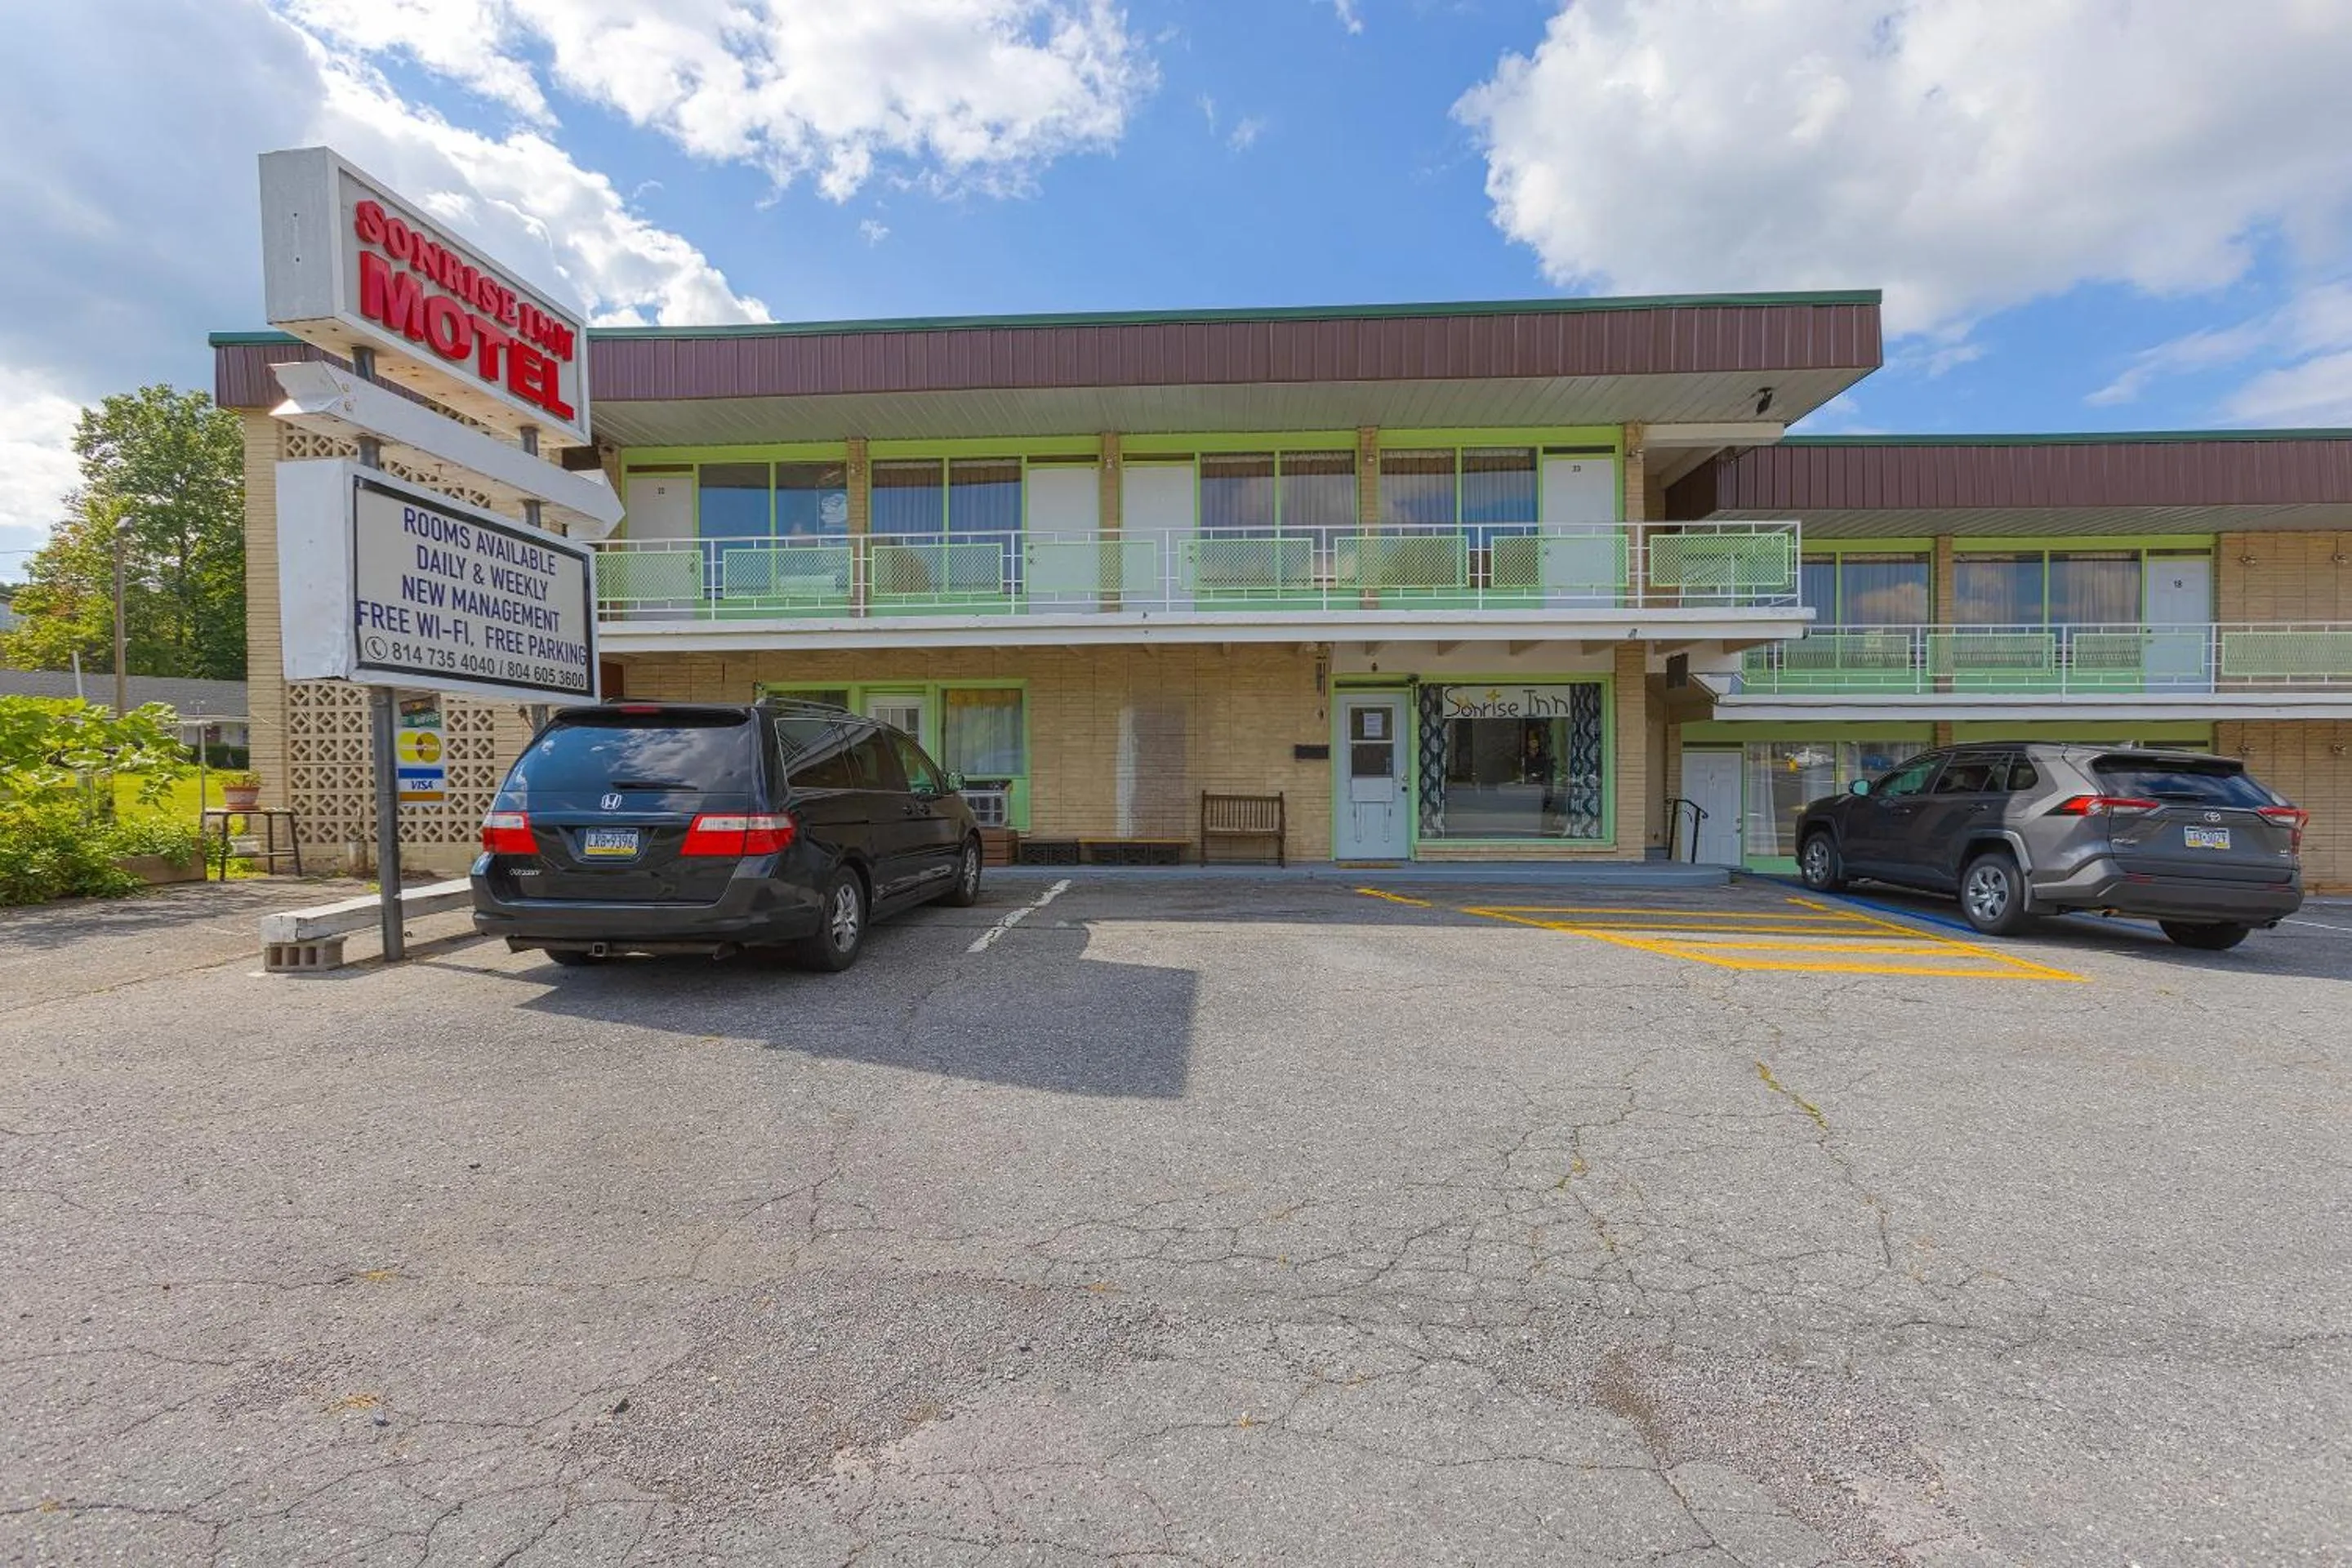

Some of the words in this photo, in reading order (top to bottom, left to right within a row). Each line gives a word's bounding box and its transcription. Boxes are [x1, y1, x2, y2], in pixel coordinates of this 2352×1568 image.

[354, 199, 518, 327] SONRISE
[359, 250, 575, 421] MOTEL
[403, 507, 470, 550] ROOMS
[476, 532, 556, 577] AVAILABLE
[416, 544, 466, 581] DAILY
[473, 563, 484, 586] &
[490, 564, 548, 602] WEEKLY
[354, 600, 411, 635] FREE
[485, 626, 525, 655] FREE
[528, 635, 587, 666] PARKING
[402, 574, 445, 608] NEW
[452, 586, 560, 633] MANAGEMENT
[392, 642, 422, 663] 814
[427, 648, 456, 669] 735
[461, 653, 495, 675] 4040
[499, 660, 504, 675] /
[507, 662, 531, 679] 804
[534, 666, 556, 685] 605
[559, 672, 585, 688] 3600
[1444, 688, 1519, 717] Sonrise
[1522, 689, 1569, 717] Inn
[411, 780, 434, 790] VISA
